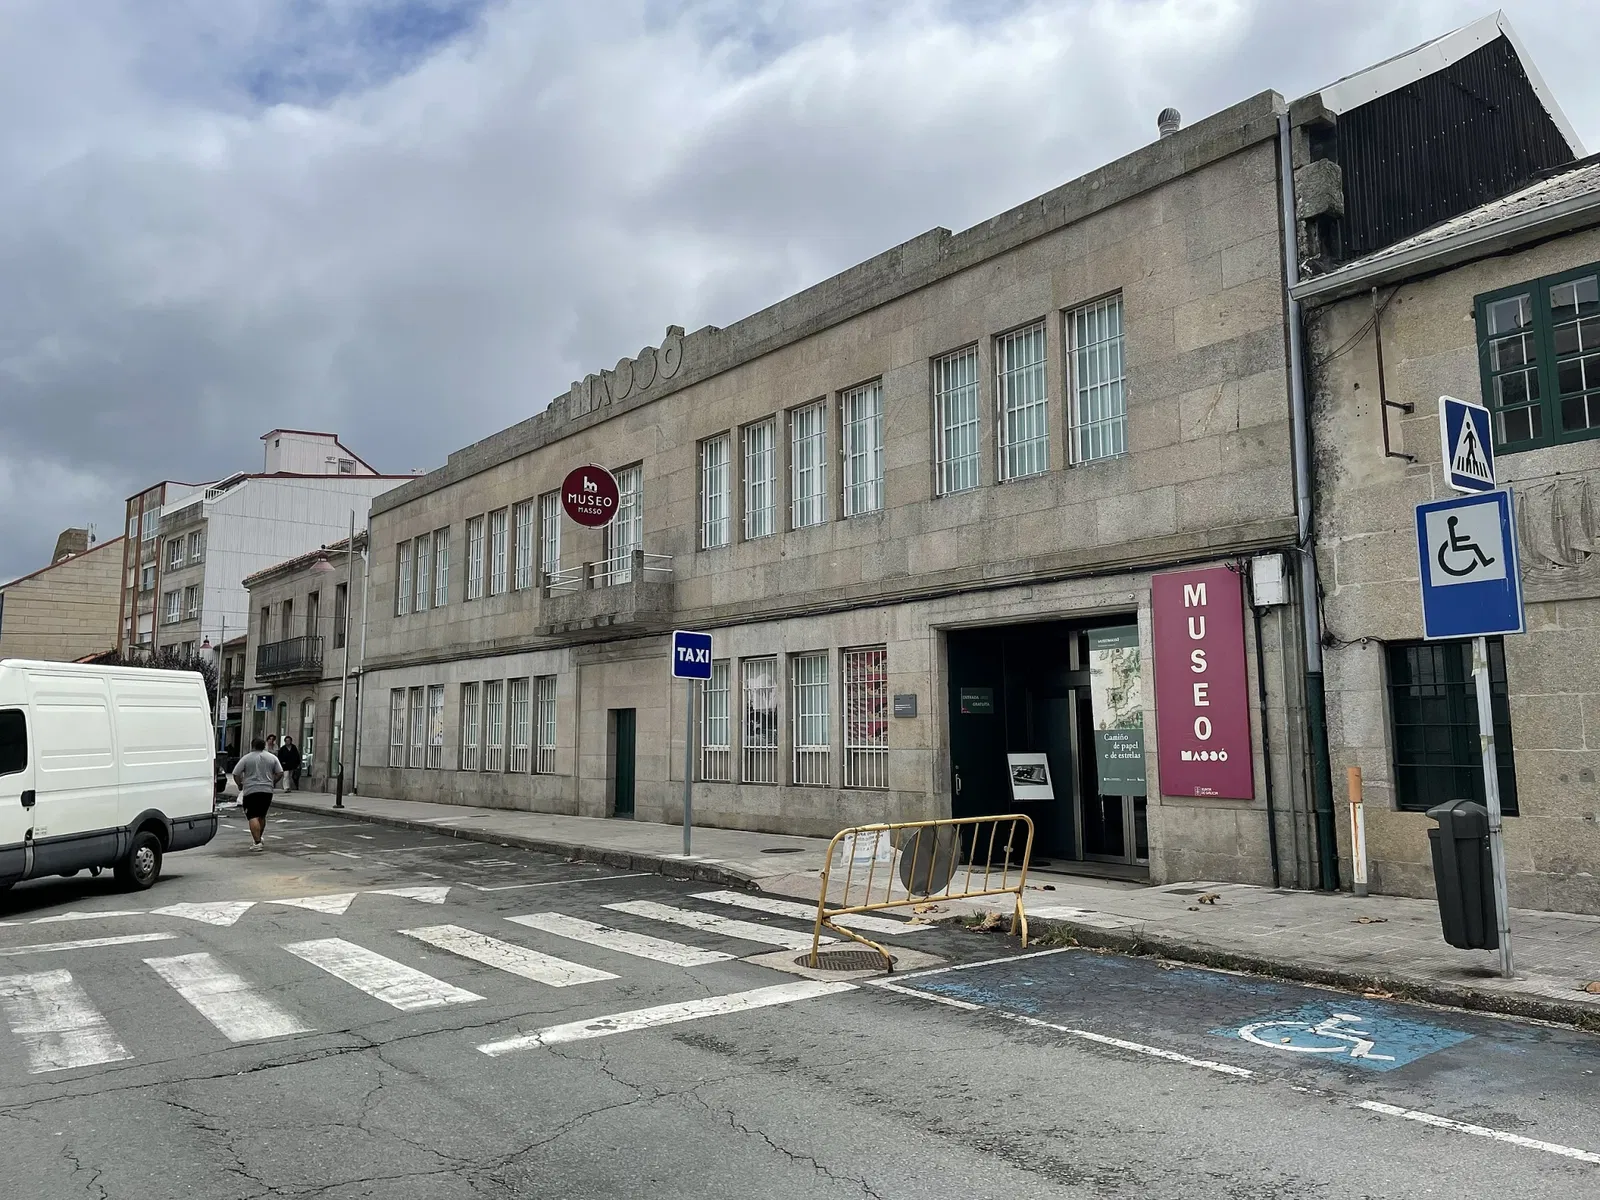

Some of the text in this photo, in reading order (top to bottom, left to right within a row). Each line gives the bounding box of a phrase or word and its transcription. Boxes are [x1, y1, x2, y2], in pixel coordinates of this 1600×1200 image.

[568, 493, 612, 507] MUSEO
[677, 647, 709, 663] TAXI
[1183, 582, 1212, 741] MUSEO
[1103, 733, 1129, 741] Camiño
[1113, 741, 1139, 751] de papel
[1110, 751, 1118, 759] de
[1118, 751, 1141, 759] estrelas
